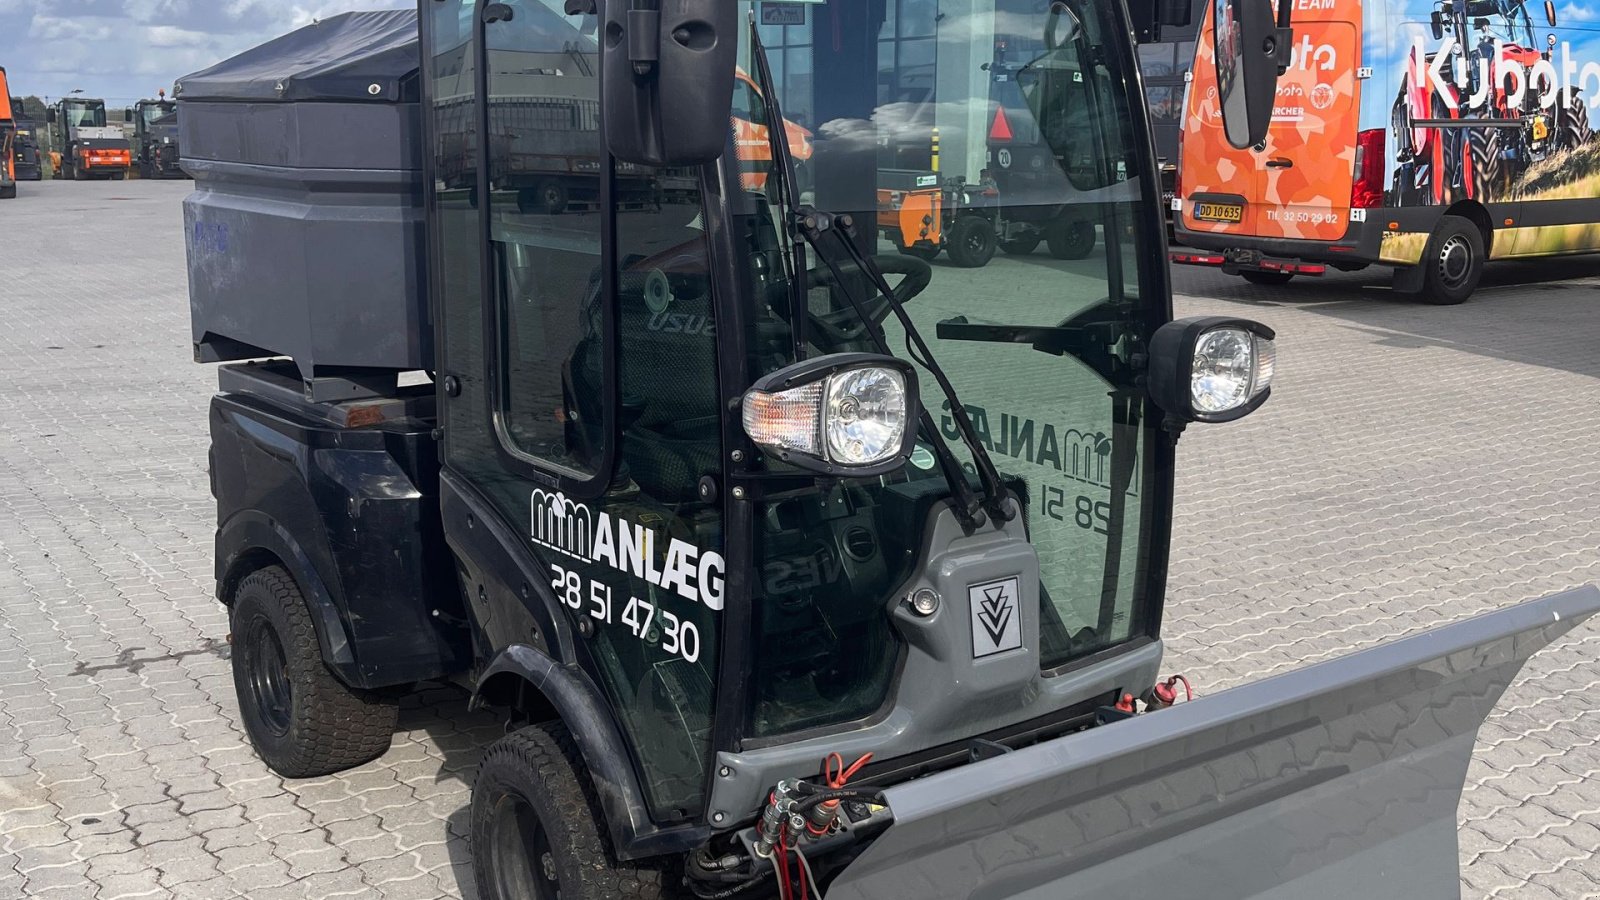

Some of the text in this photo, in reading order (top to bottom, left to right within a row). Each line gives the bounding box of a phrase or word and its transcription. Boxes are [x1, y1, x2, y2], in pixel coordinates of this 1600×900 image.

[1414, 36, 1600, 109] Kubota
[1001, 151, 1010, 166] 20
[1200, 204, 1240, 218] DD 10 635
[1284, 211, 1295, 222] 32
[1297, 212, 1309, 223] 50
[1311, 213, 1323, 224] 29
[1325, 213, 1338, 225] 02
[593, 512, 725, 611] ANLÆG
[551, 564, 700, 664] 28 51 47 30
